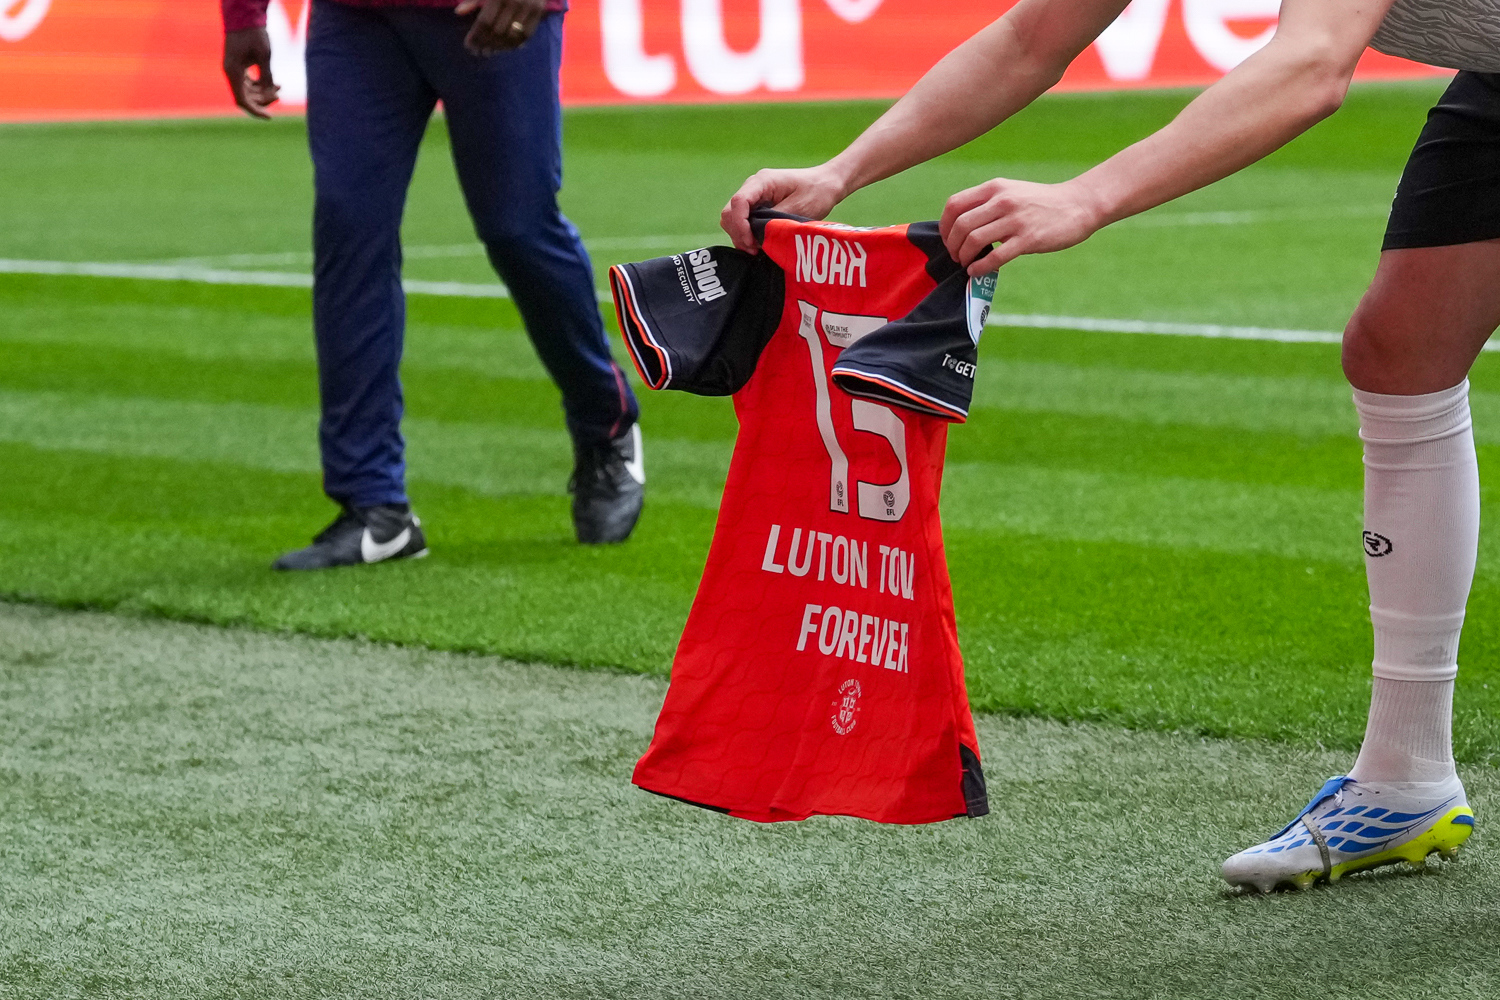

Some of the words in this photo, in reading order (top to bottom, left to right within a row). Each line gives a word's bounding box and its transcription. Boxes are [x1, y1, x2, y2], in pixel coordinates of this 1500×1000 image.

[676, 266, 696, 302] SECURITY
[795, 233, 867, 288] NOAH
[797, 299, 911, 522] 15
[886, 508, 895, 516] EFL
[761, 524, 868, 589] LUTON
[796, 603, 909, 674] FOREVER
